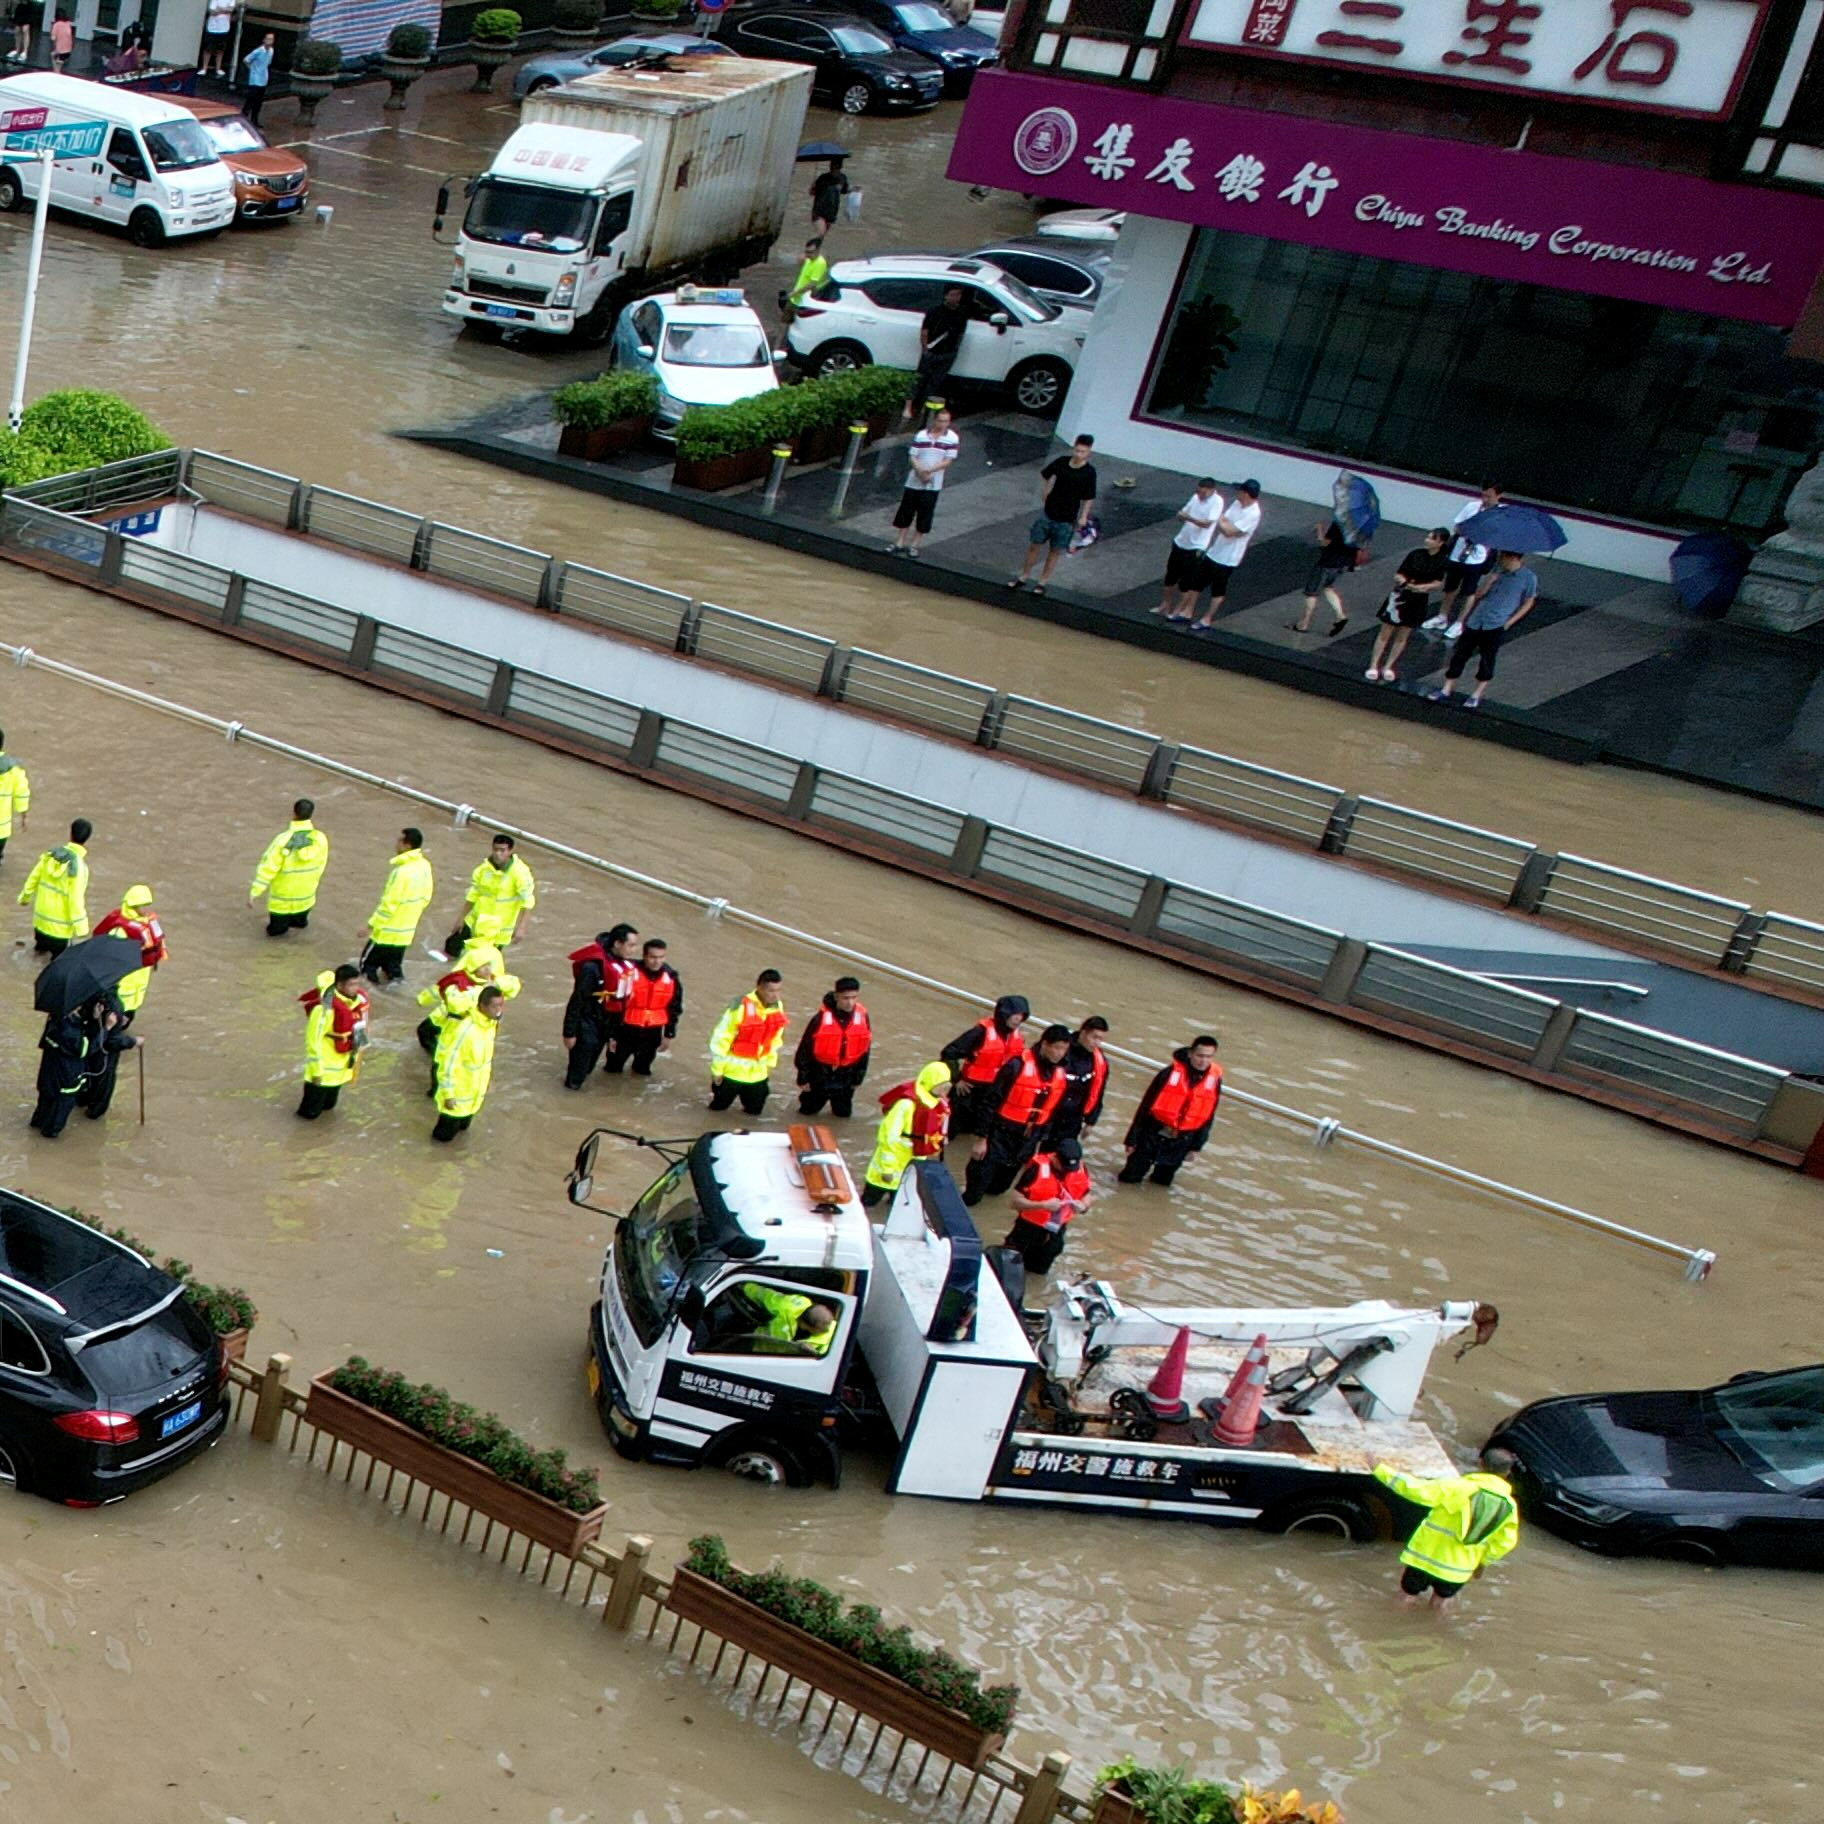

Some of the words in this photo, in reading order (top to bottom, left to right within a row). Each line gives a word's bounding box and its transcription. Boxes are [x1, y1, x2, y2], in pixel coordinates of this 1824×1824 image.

[1083, 122, 1340, 218] 集友銀行
[1354, 194, 1425, 231] Chiyu
[1434, 205, 1540, 252] Banking
[1548, 225, 1698, 274] Corporation
[1706, 251, 1773, 286] Ltd.
[680, 1370, 776, 1404] 福州交警施救车
[1014, 1449, 1183, 1480] 福州交警施救车
